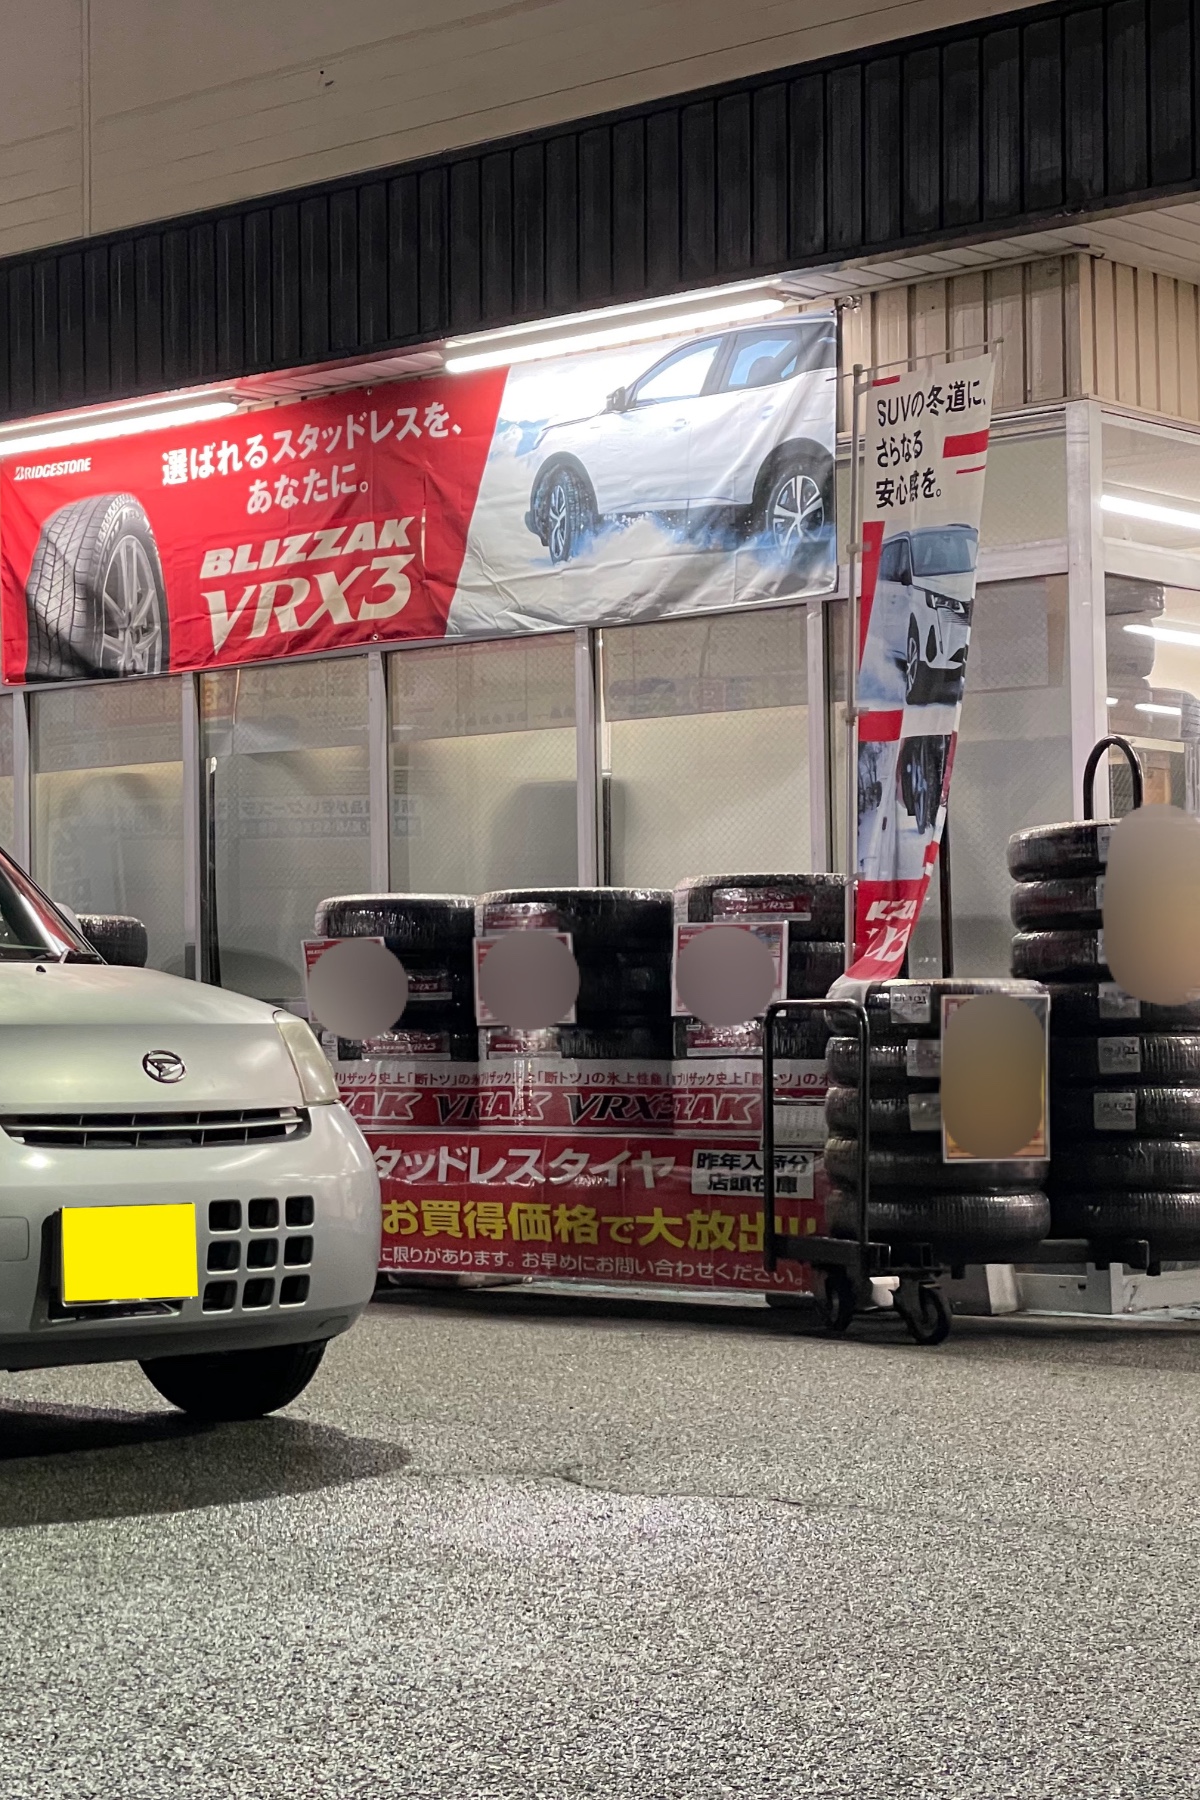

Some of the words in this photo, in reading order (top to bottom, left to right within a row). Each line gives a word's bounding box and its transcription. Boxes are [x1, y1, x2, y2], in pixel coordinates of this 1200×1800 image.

[14, 458, 91, 481] BRIDGESTONE
[162, 402, 462, 486] 選ばれるスタッドレスを、
[876, 430, 923, 468] さらなる
[246, 463, 369, 515] あなたに。
[200, 516, 415, 579] BLIZZAK
[201, 553, 416, 656] VRX3
